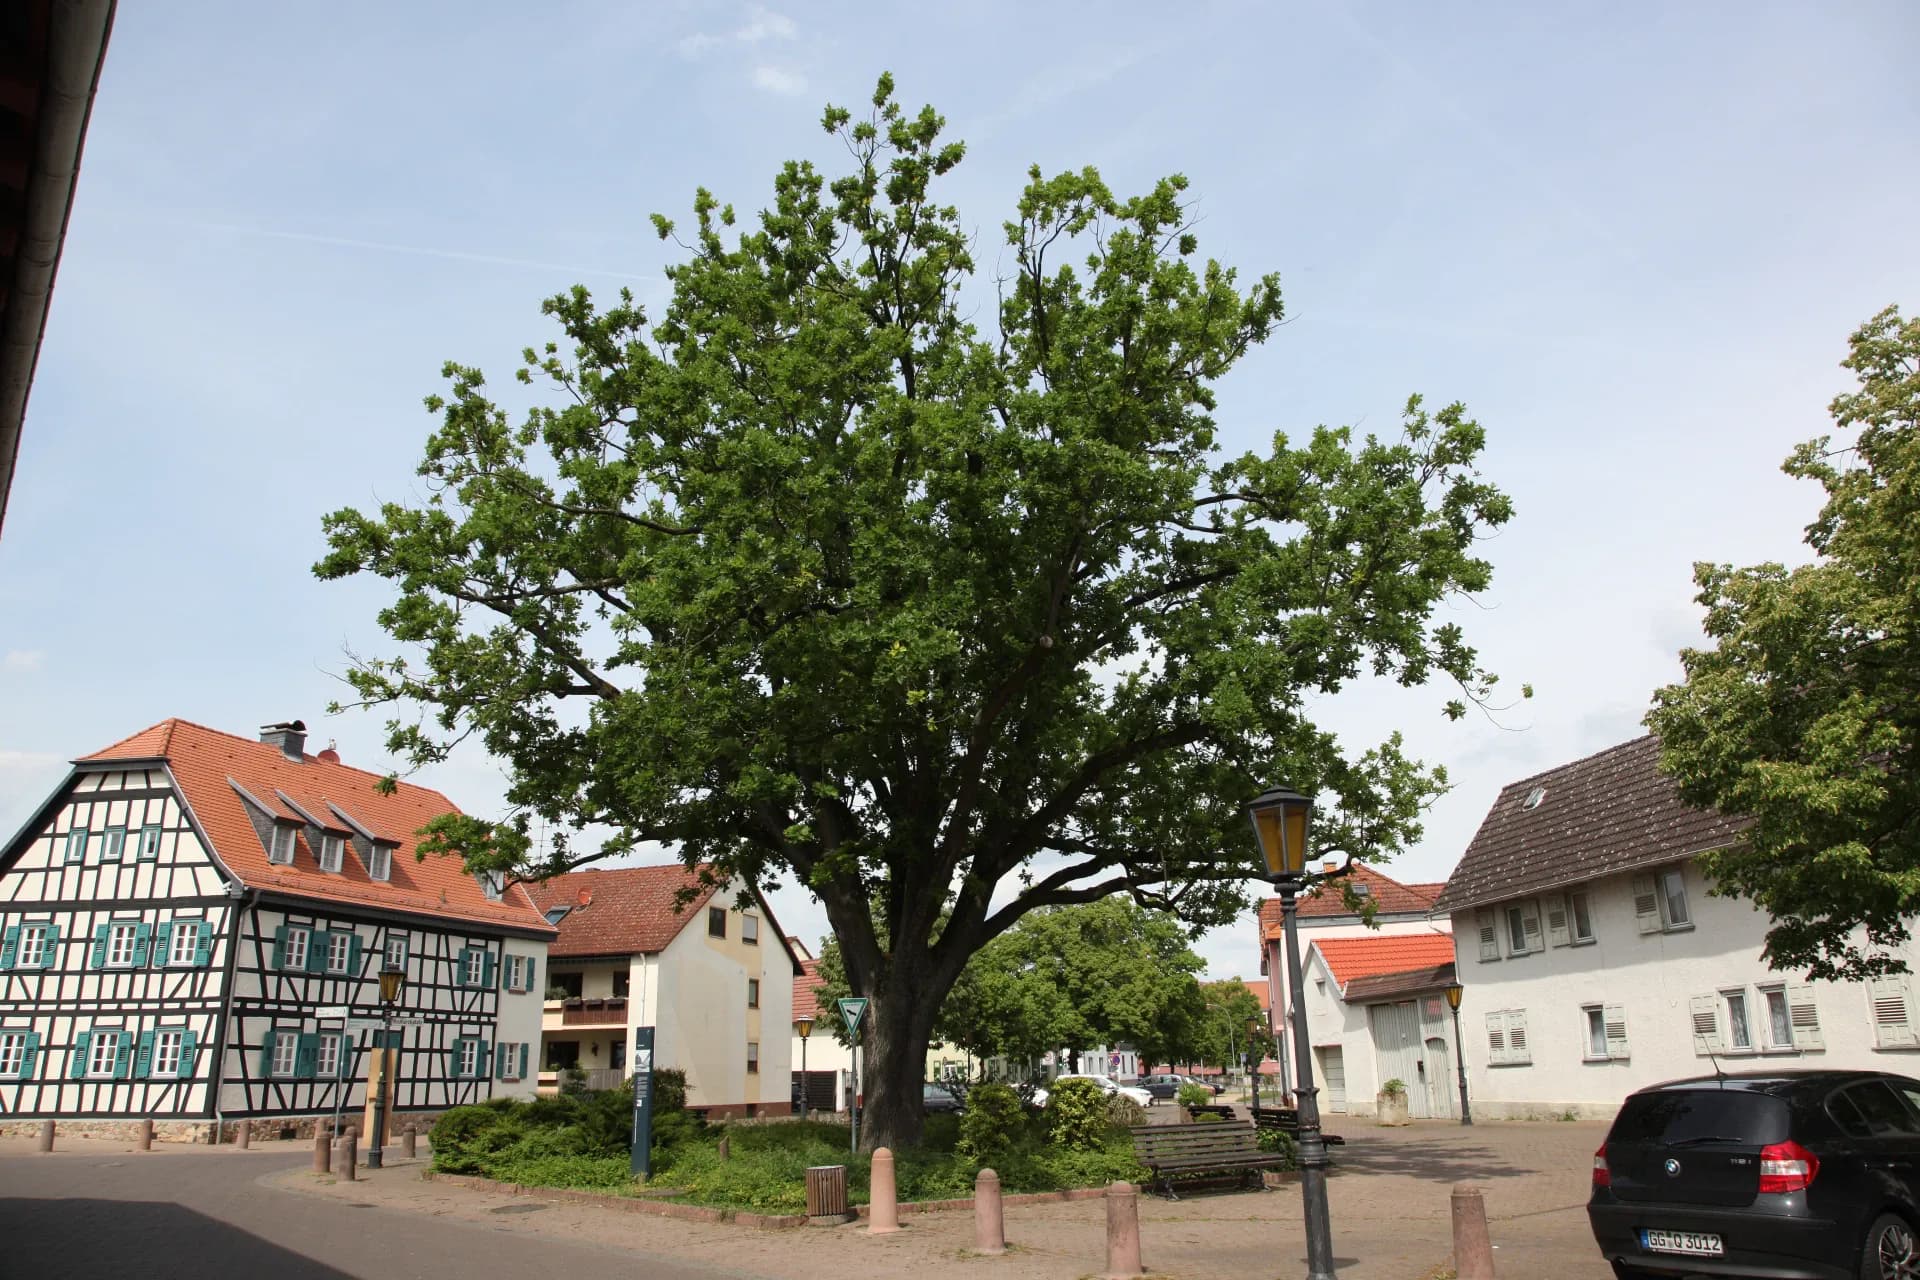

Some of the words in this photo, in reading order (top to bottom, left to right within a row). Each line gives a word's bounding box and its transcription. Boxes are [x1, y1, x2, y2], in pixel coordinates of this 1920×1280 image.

[1649, 1231, 1666, 1247] GG
[1673, 1233, 1682, 1249] Q
[1685, 1234, 1721, 1251] 3012
